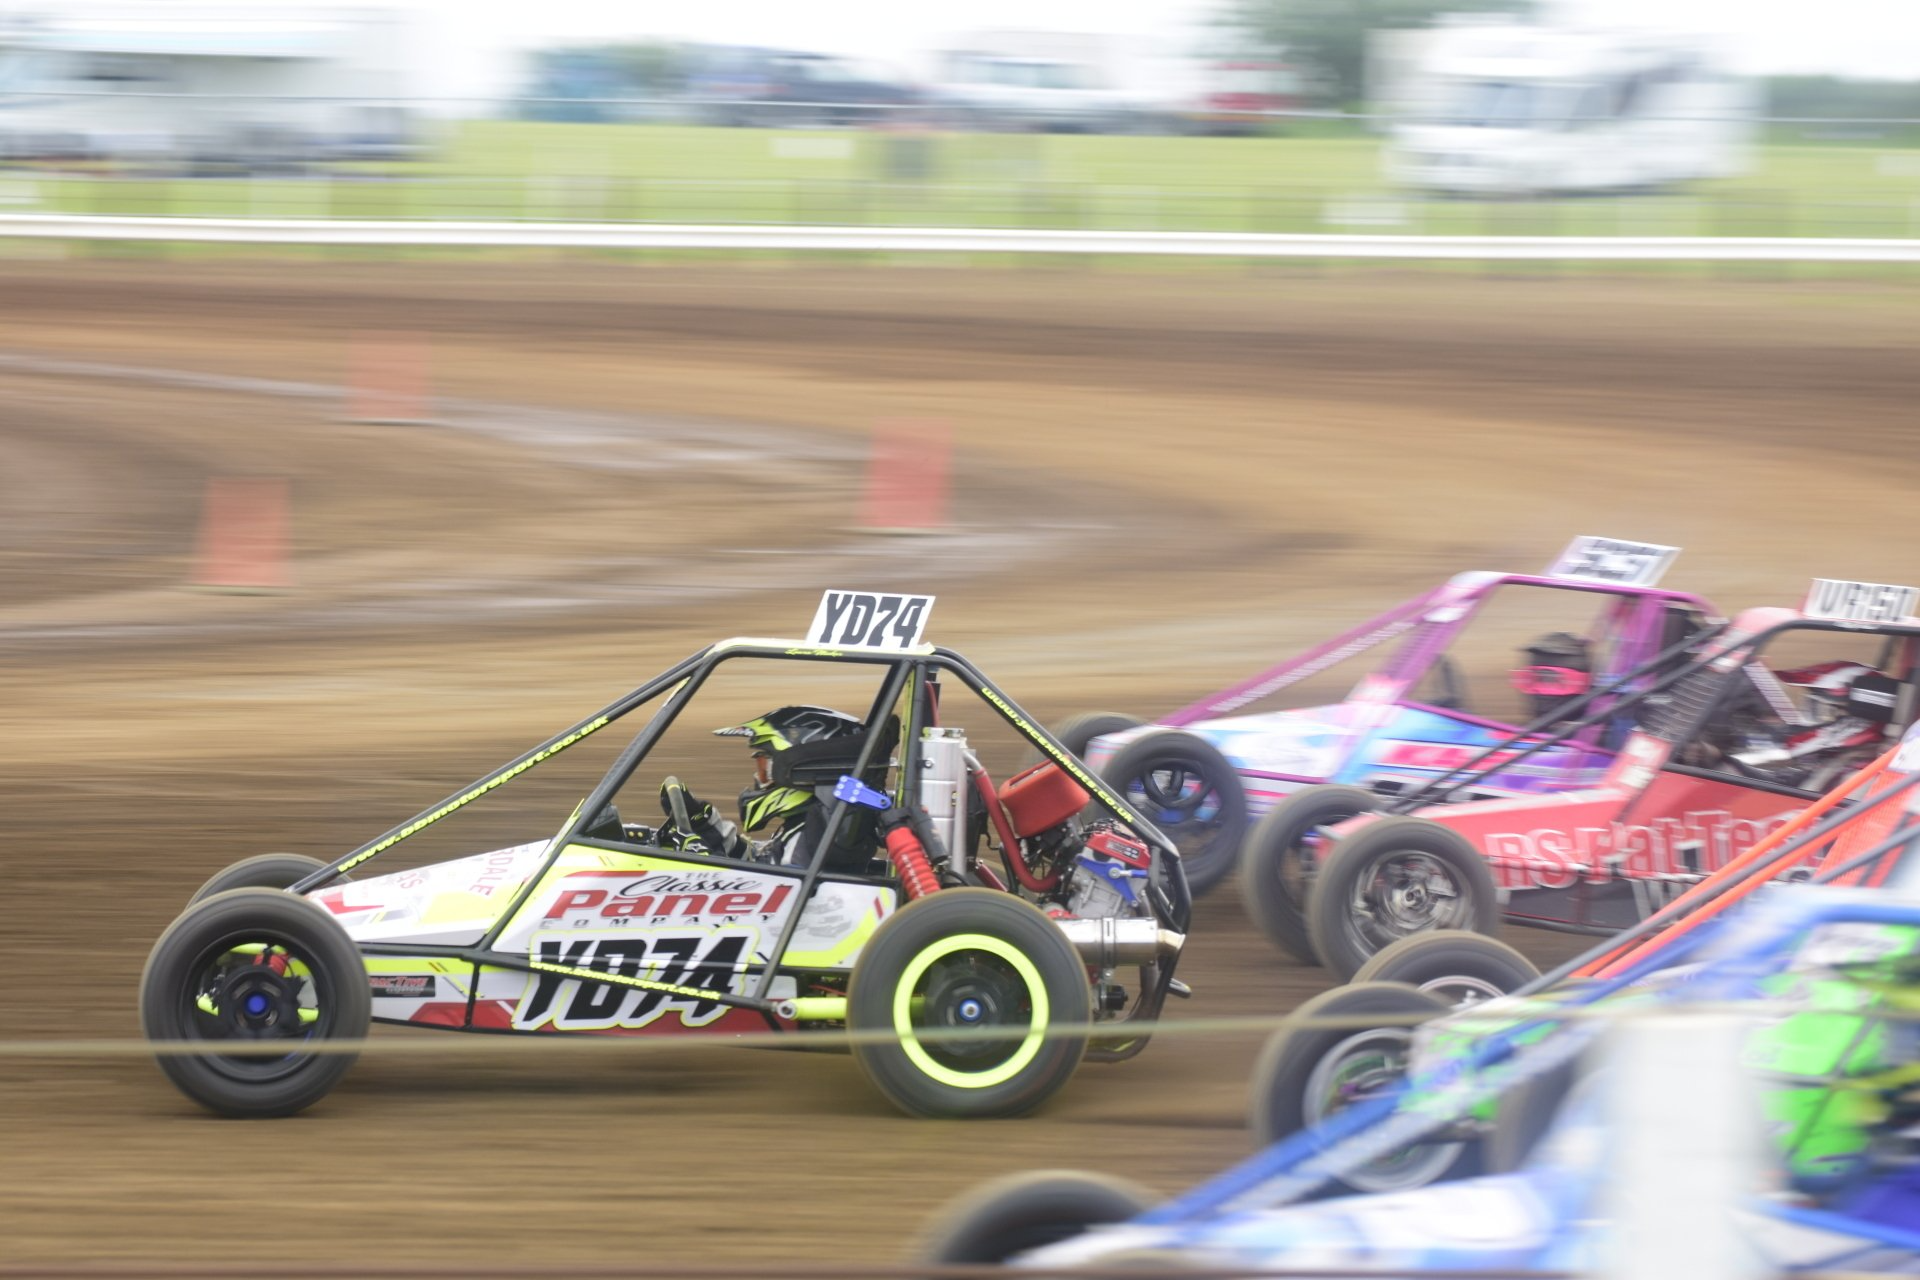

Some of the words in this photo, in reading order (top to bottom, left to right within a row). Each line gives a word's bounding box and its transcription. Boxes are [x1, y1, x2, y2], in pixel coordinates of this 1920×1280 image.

[818, 593, 928, 648] YD74
[338, 715, 609, 872] www.bbmotorsport.co.uk
[619, 875, 762, 898] Classic
[684, 872, 722, 880] THE
[544, 884, 794, 919] Panel
[539, 914, 775, 929] COMPANY
[523, 936, 749, 1020] YD74
[529, 961, 721, 1000] www.bbmotorsport.co.uk
